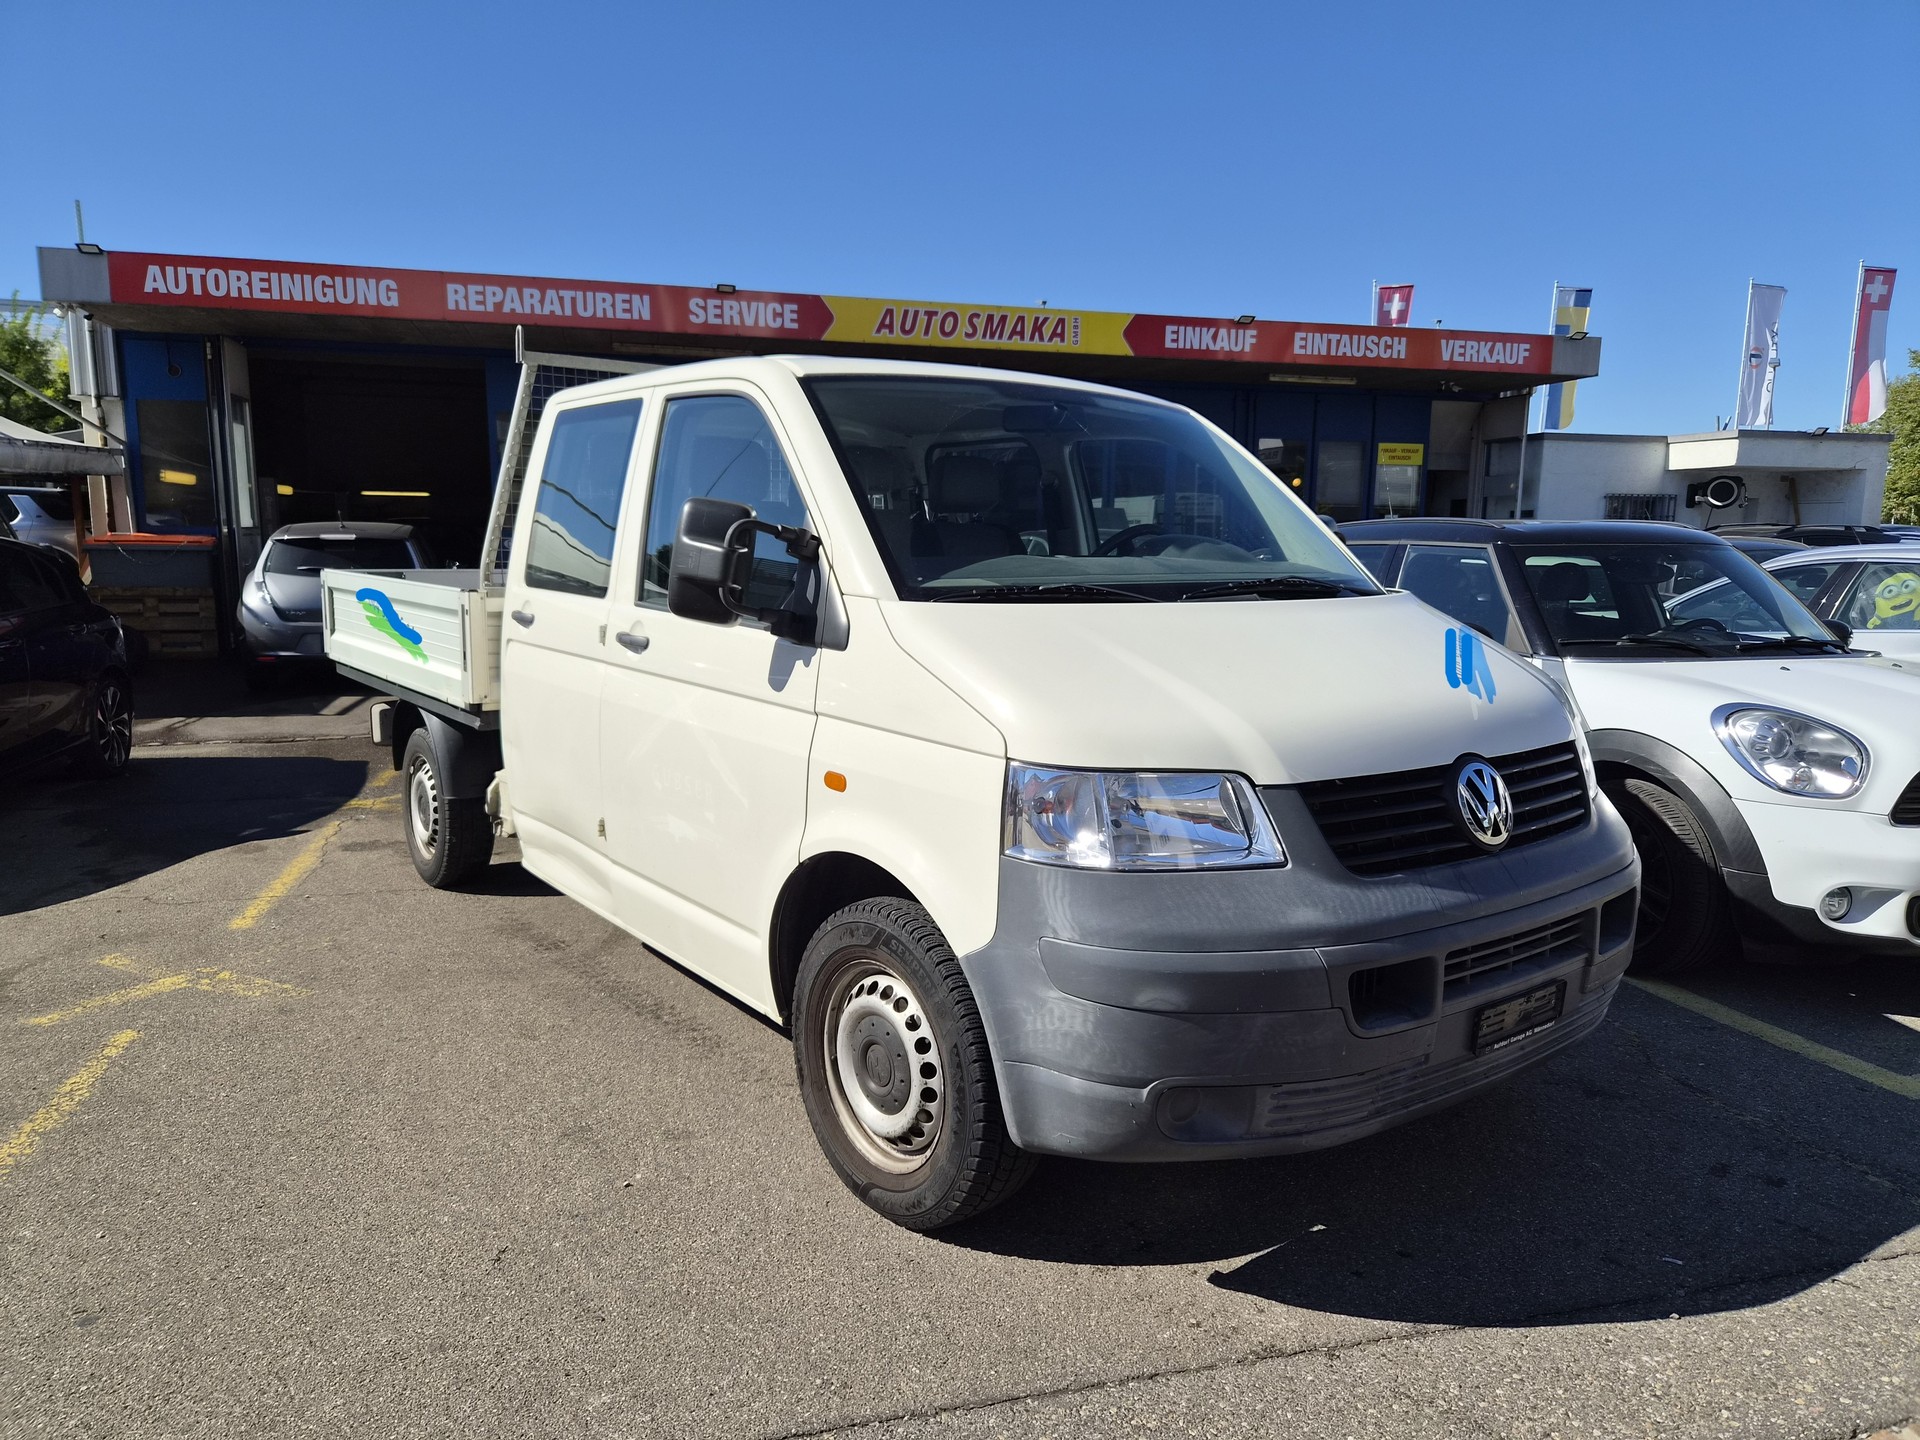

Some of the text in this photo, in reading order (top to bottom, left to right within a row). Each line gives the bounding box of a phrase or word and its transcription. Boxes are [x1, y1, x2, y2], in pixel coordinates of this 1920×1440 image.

[144, 265, 799, 329] AUTOREINIGUNG REPARATUREN SERVICE
[873, 306, 1067, 345] AUTO SMAKA
[1071, 316, 1080, 346] GMBH
[1164, 325, 1530, 365] EINKAUF EINTAUSCH VERKAUF
